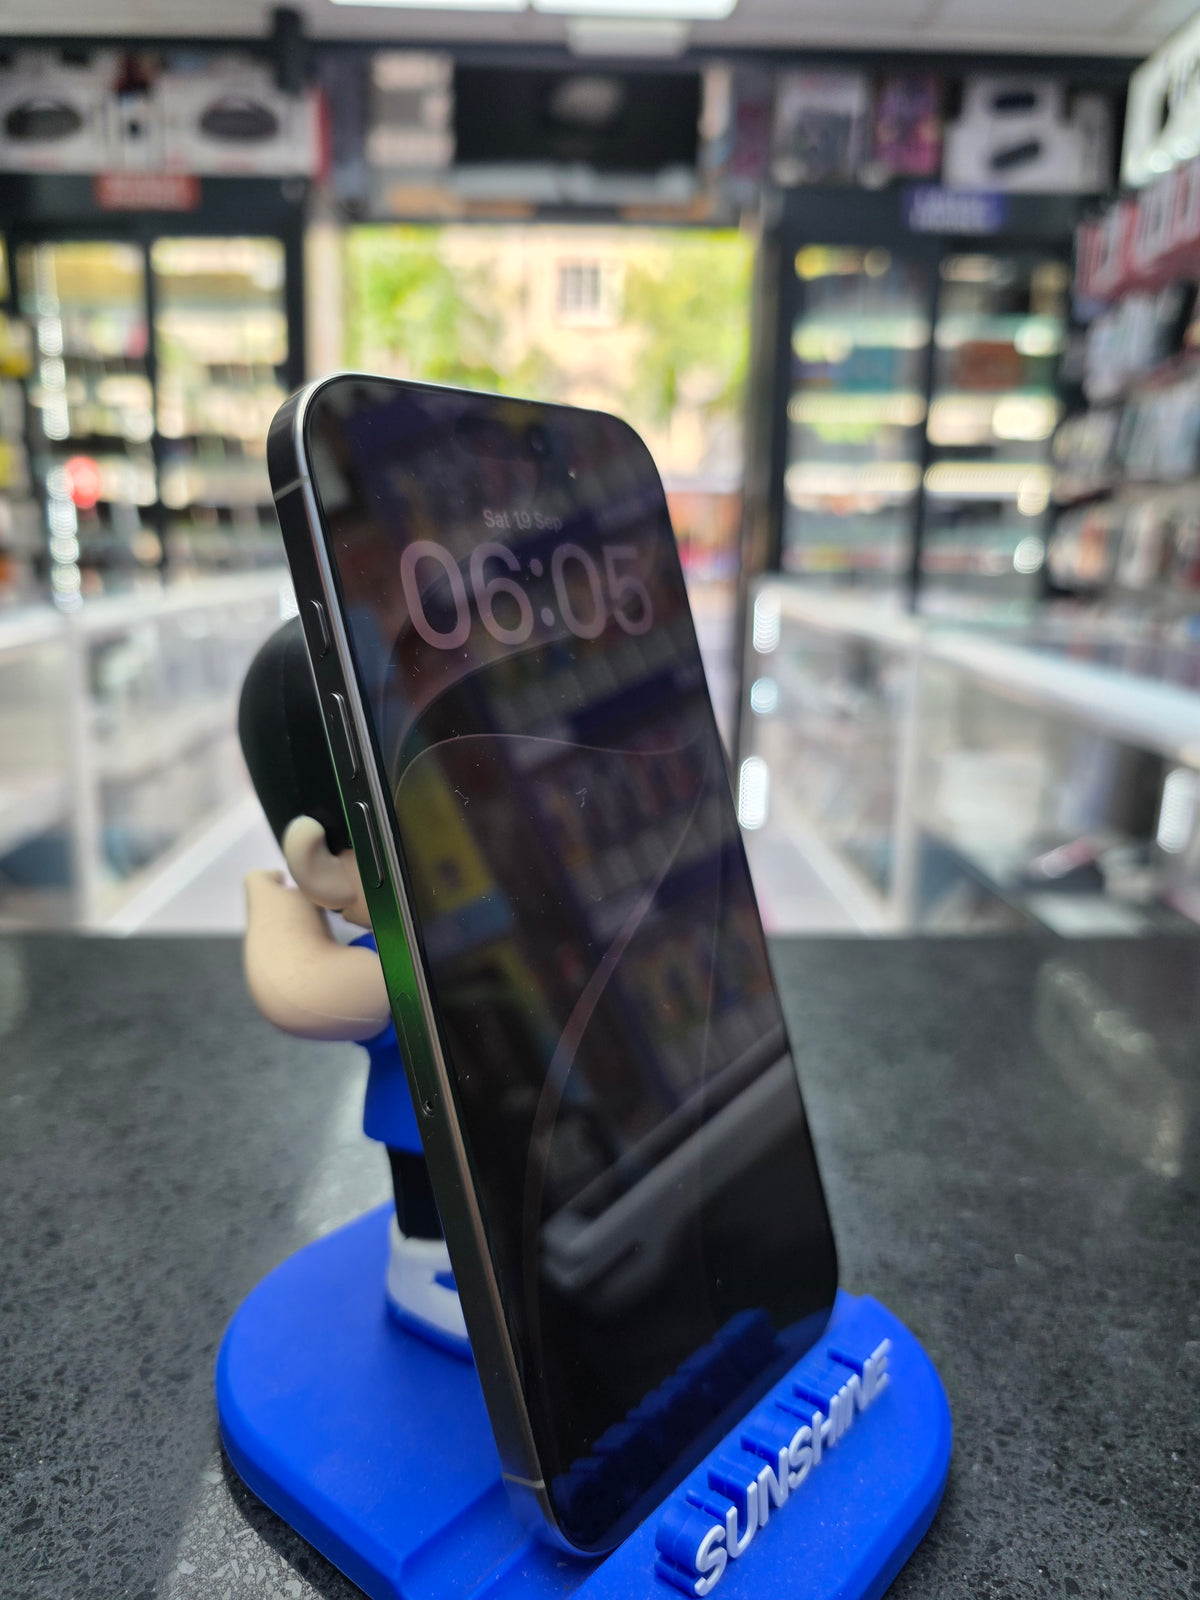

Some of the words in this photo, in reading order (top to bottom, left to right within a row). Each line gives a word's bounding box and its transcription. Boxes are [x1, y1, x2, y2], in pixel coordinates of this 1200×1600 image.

[482, 509, 512, 528] Sat
[512, 511, 532, 530] 19
[534, 512, 563, 534] Sep
[400, 540, 654, 650] 06:05
[694, 1338, 891, 1597] SUNSHINE
